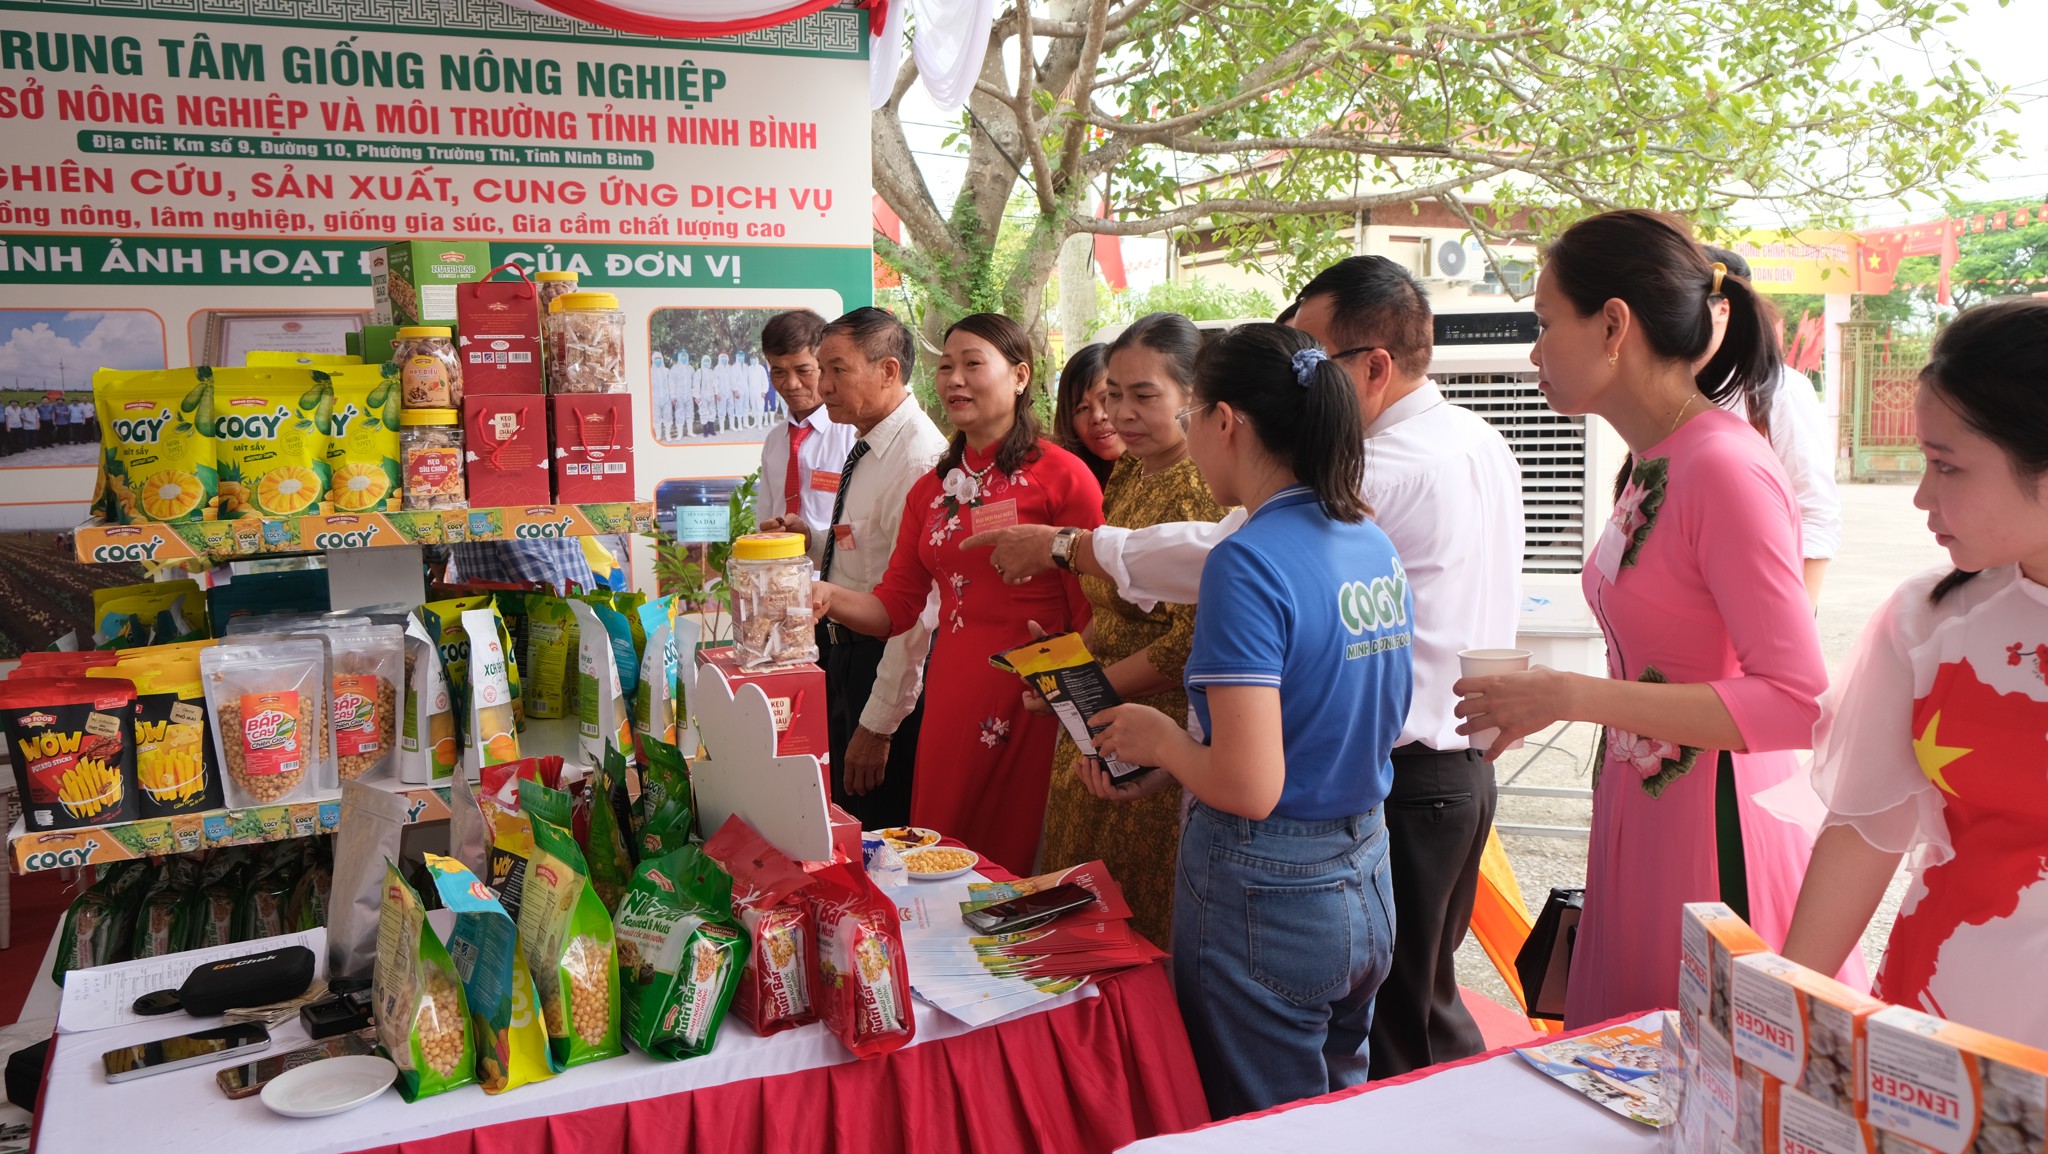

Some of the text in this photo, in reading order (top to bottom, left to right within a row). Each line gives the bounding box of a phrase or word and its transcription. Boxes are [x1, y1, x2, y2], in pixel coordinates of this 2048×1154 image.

[158, 32, 265, 82] TÂM
[282, 36, 424, 90] GIỐNG
[440, 49, 562, 96] NÔNG
[577, 59, 726, 110] NGHIỆP
[0, 77, 817, 149] SỞ NÔNG NGHIỆP VÀ MÔI TRƯỜNG TỈNH NINH BÌNH
[92, 134, 643, 166] Địa chỉ: Km số 9, Đường 10, Phường Trường Thi, Tỉnh Ninh Bình
[130, 162, 237, 202] CỨU,
[250, 164, 333, 199] SẢN
[349, 165, 459, 206] XUẤT,
[473, 178, 587, 205] CUNG
[600, 175, 678, 207] ỨNG
[691, 184, 777, 215] DỊCH
[789, 188, 833, 217] VỤ
[61, 204, 141, 229] nông,
[151, 206, 203, 227] lâm
[214, 209, 314, 233] nghiệp,
[324, 208, 396, 233] giống
[405, 212, 444, 233] gia
[453, 211, 504, 234] súc,
[512, 214, 551, 233] Gia
[560, 212, 610, 234] cầm
[619, 213, 669, 235] chất
[677, 218, 739, 239] lượng
[746, 221, 786, 237] cao
[100, 238, 203, 273] ẢNH
[220, 249, 344, 281] HOẠT
[503, 244, 592, 276] CỦA
[605, 251, 692, 277] ĐƠN
[704, 255, 741, 284] VỊ
[459, 265, 476, 274] BAR
[215, 416, 281, 439] COGY
[233, 442, 265, 452] MÍT SẤY
[316, 532, 372, 549] COGY
[515, 523, 567, 538] COGY
[95, 543, 157, 562] COGY
[1341, 577, 1404, 630] COGY
[1346, 640, 1370, 660] MINH
[20, 715, 53, 725] MD FOOD
[247, 709, 282, 732] BẮP
[251, 725, 276, 739] CAY
[18, 731, 82, 762] WOW
[252, 739, 271, 749] Chiên
[32, 755, 73, 773] POTATO STICKS
[26, 848, 92, 871] COGY
[823, 898, 848, 927] Bar
[653, 921, 671, 934] Nuts
[213, 954, 277, 971] GoChek
[772, 971, 785, 991] Bar
[685, 981, 697, 1005] Bar
[863, 985, 877, 1006] Bar
[1735, 1008, 1795, 1053] LENGER
[1872, 1072, 1960, 1120] LENGER
